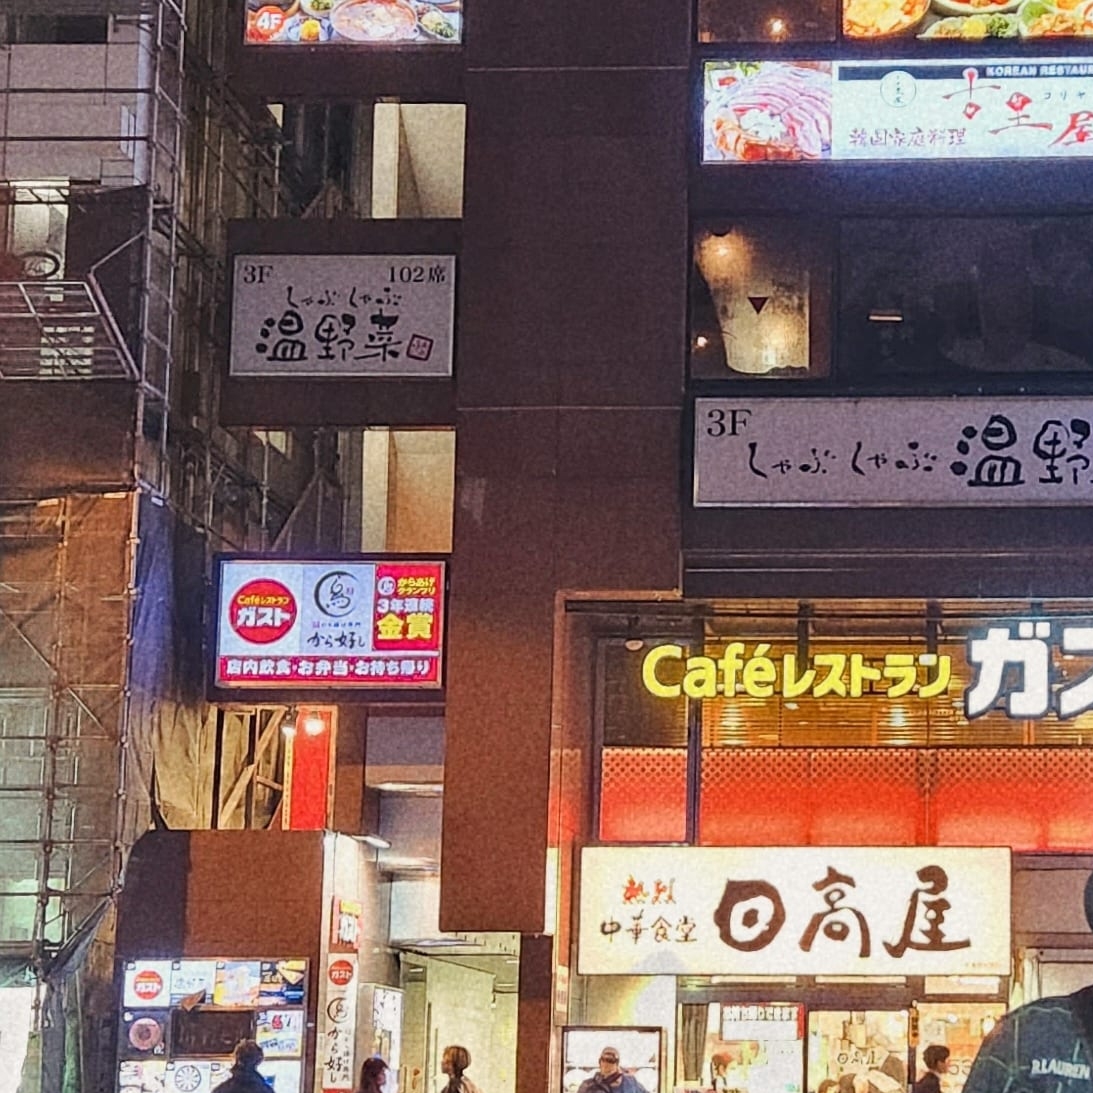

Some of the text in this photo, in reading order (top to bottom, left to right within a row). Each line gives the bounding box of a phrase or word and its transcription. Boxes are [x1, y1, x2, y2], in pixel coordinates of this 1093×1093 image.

[257, 12, 282, 30] 4F
[985, 64, 1037, 77] KOREAN
[243, 264, 273, 283] 3F
[388, 264, 446, 283] 102席
[706, 408, 752, 437] 3F
[237, 606, 291, 628] ガスト
[377, 612, 434, 639] 金賞
[713, 865, 971, 958] 日高屋
[600, 908, 698, 945] 中華食堂
[331, 970, 352, 981] ガスト
